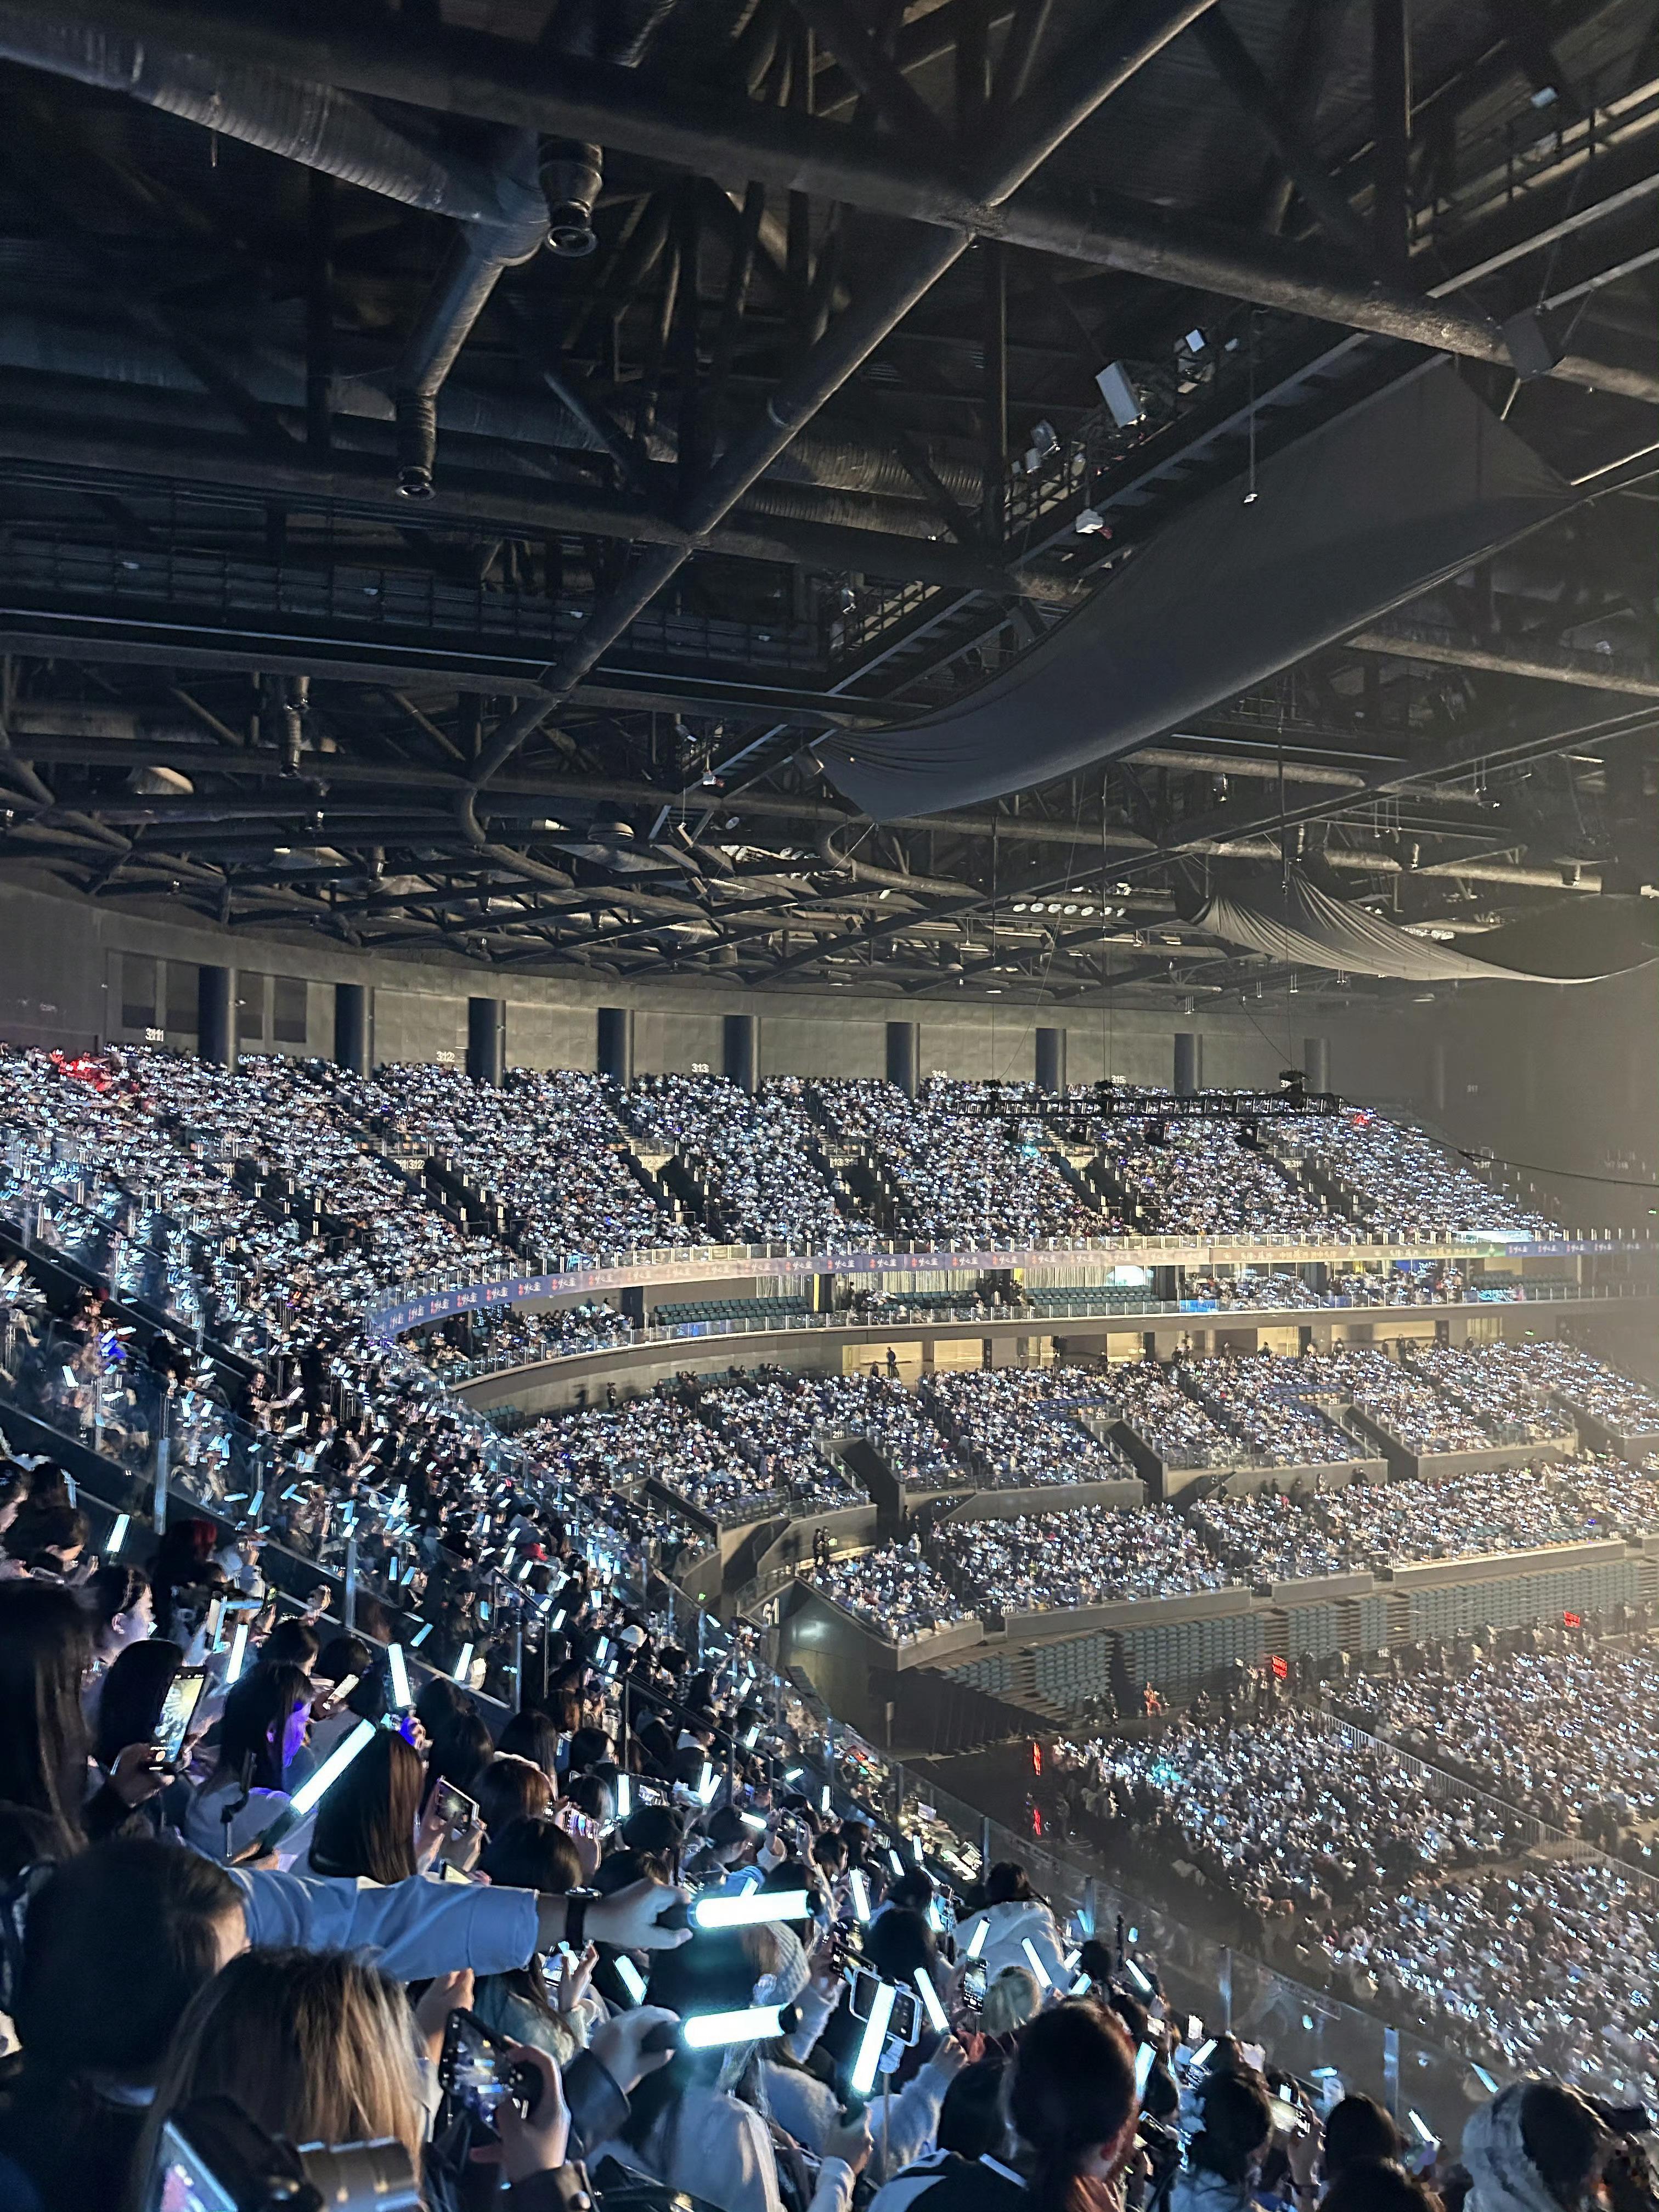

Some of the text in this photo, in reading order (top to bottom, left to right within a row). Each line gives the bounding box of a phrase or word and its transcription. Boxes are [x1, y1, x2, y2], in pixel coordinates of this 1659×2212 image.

[436, 1051, 455, 1062] 312
[692, 1063, 709, 1073] 313
[932, 1070, 948, 1079] 314
[1111, 1075, 1127, 1084] 315
